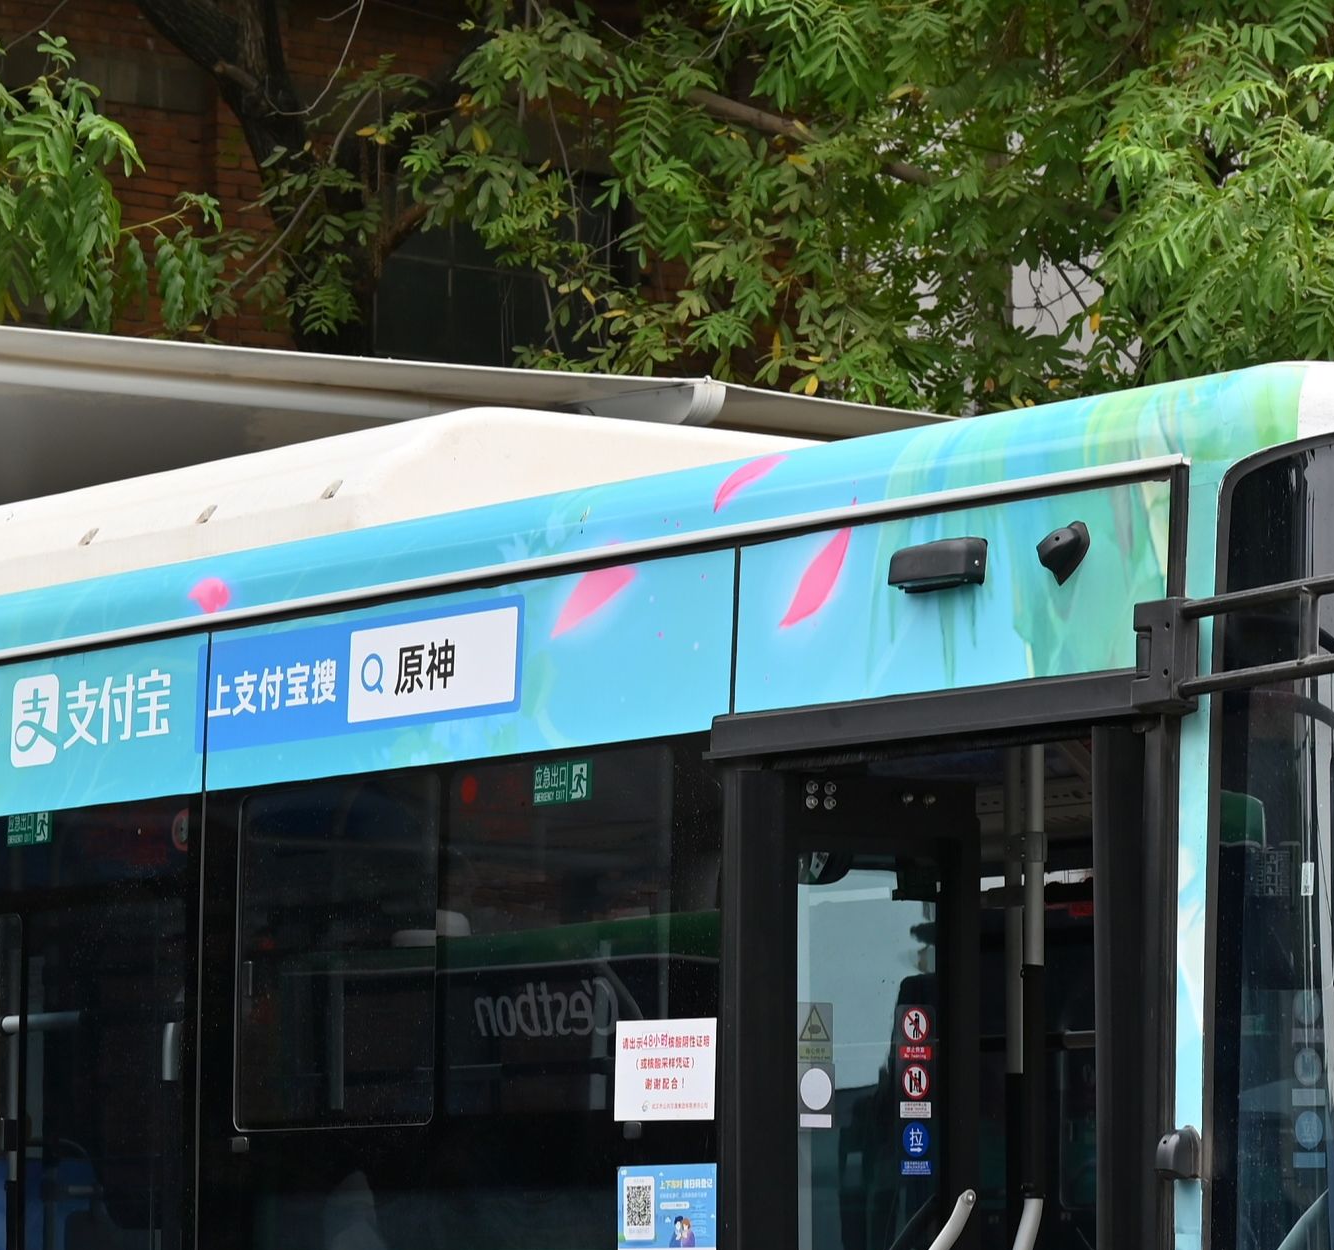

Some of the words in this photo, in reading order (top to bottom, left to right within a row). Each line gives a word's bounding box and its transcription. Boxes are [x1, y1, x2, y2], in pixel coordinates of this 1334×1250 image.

[208, 658, 337, 718] 上支付宝搜
[395, 639, 455, 695] 原神
[63, 669, 171, 750] 支付宝
[534, 764, 567, 790] 应急出口
[909, 1128, 924, 1146] 拉
